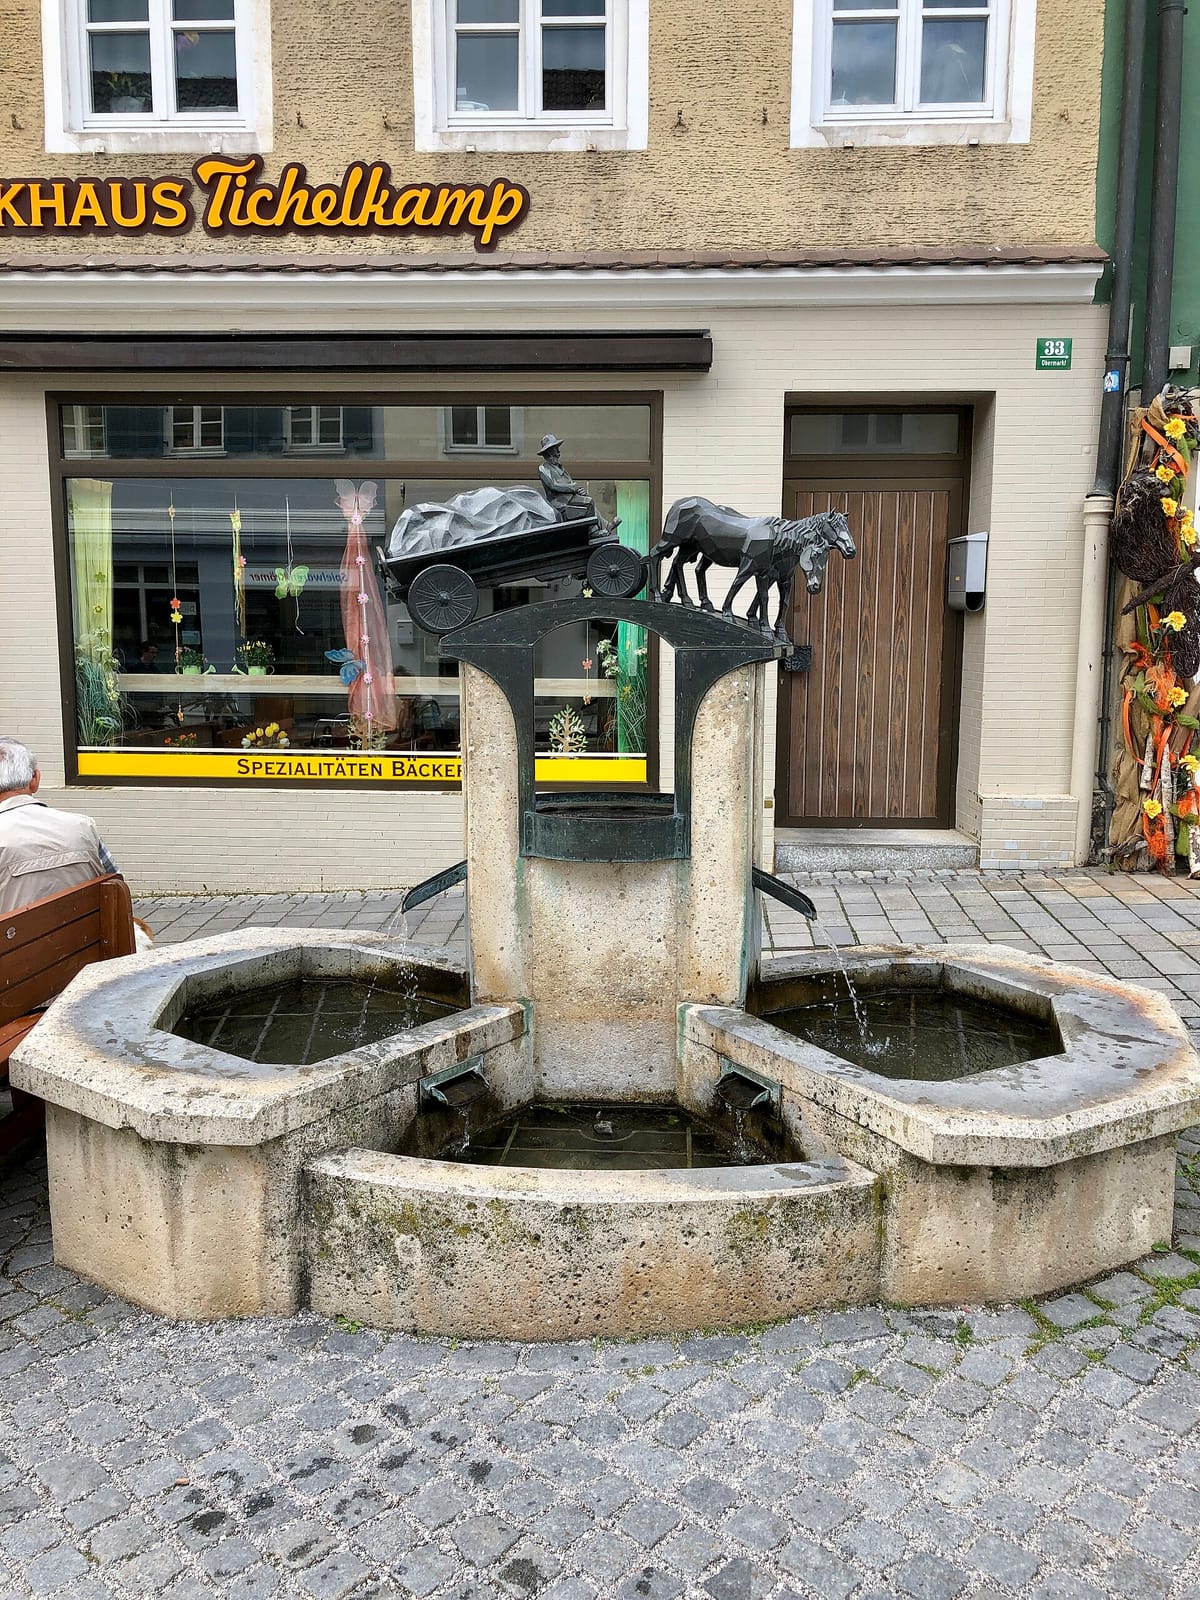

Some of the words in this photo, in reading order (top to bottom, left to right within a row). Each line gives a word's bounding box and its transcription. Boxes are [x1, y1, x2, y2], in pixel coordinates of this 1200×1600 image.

[0, 182, 187, 228] KHAUS
[199, 159, 523, 245] Tichelkamp
[1044, 340, 1065, 355] 33
[1041, 359, 1067, 367] Obermarkt
